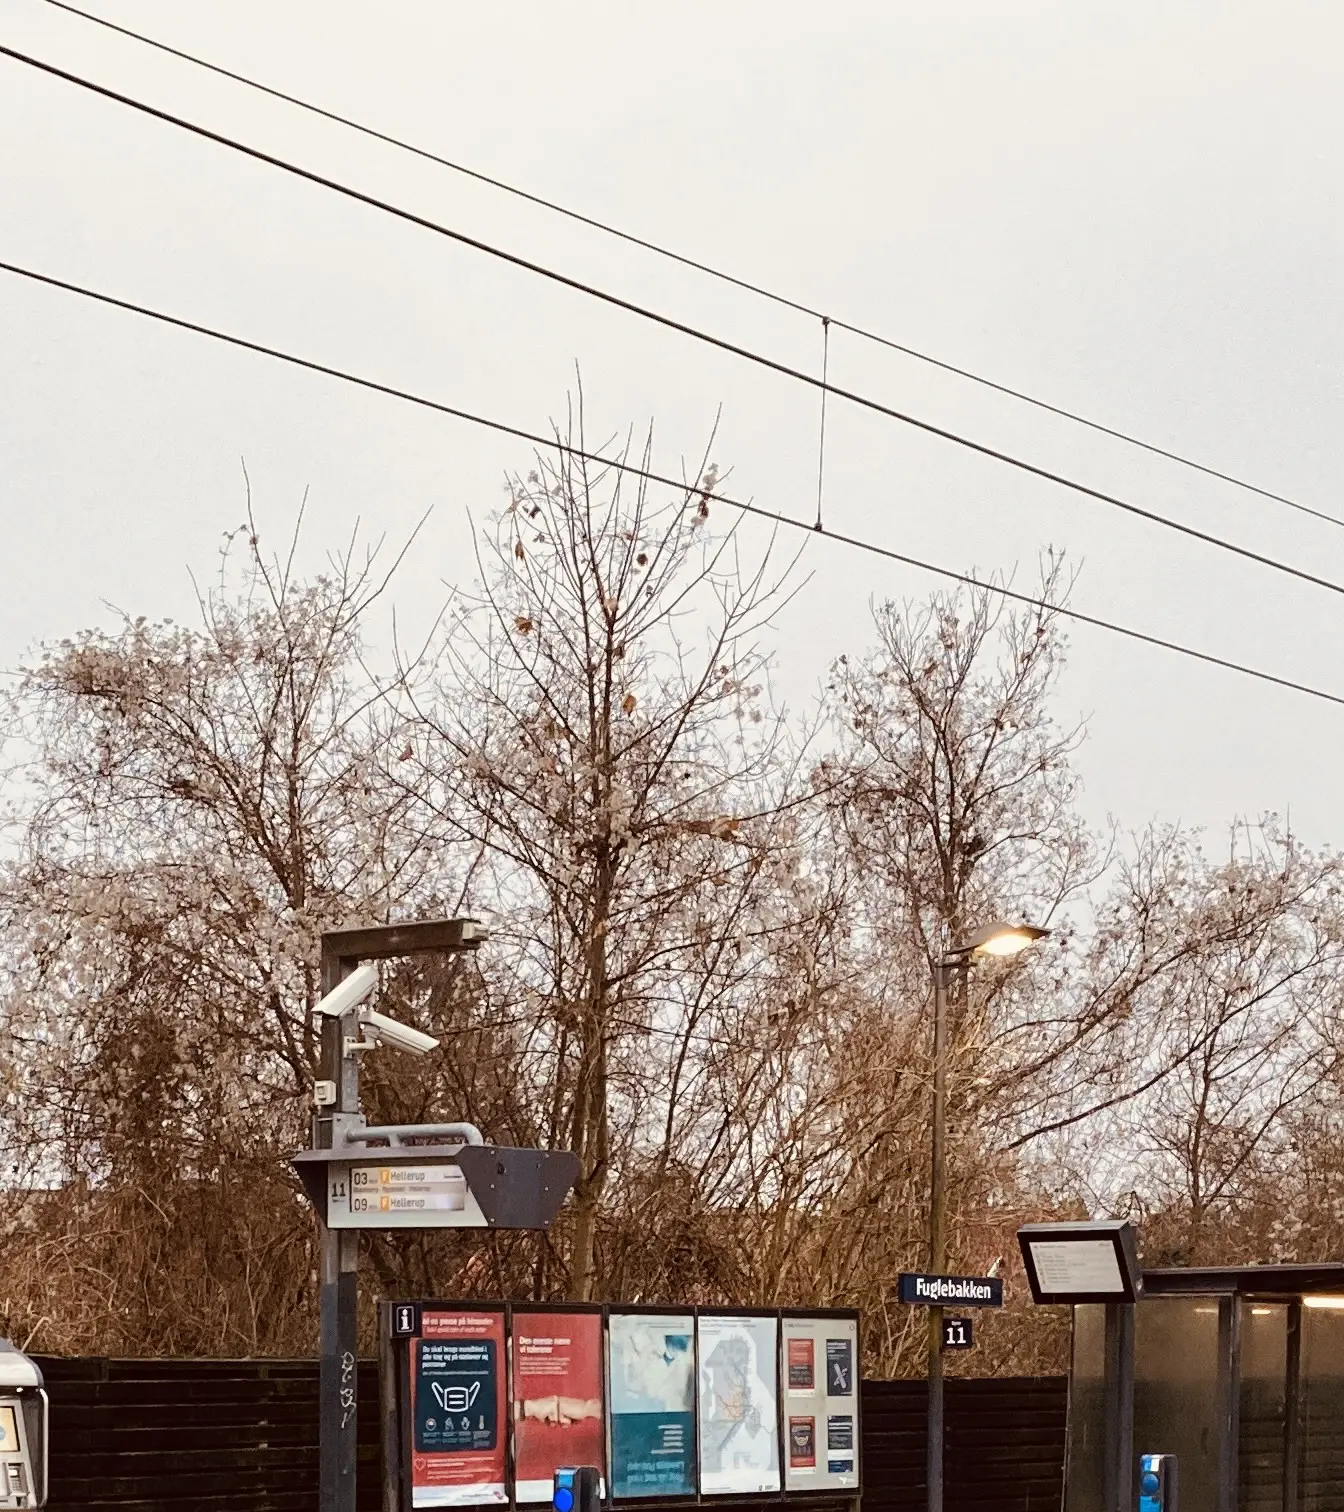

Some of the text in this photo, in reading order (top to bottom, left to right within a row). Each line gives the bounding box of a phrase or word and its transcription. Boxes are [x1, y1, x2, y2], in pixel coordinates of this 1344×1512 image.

[354, 1172, 367, 1185] 03
[391, 1171, 425, 1181] Hellerup
[331, 1182, 346, 1197] 11
[354, 1198, 367, 1211] 09
[391, 1198, 425, 1209] Hellerup
[916, 1278, 991, 1299] Fuglebakken
[946, 1327, 966, 1344] 11
